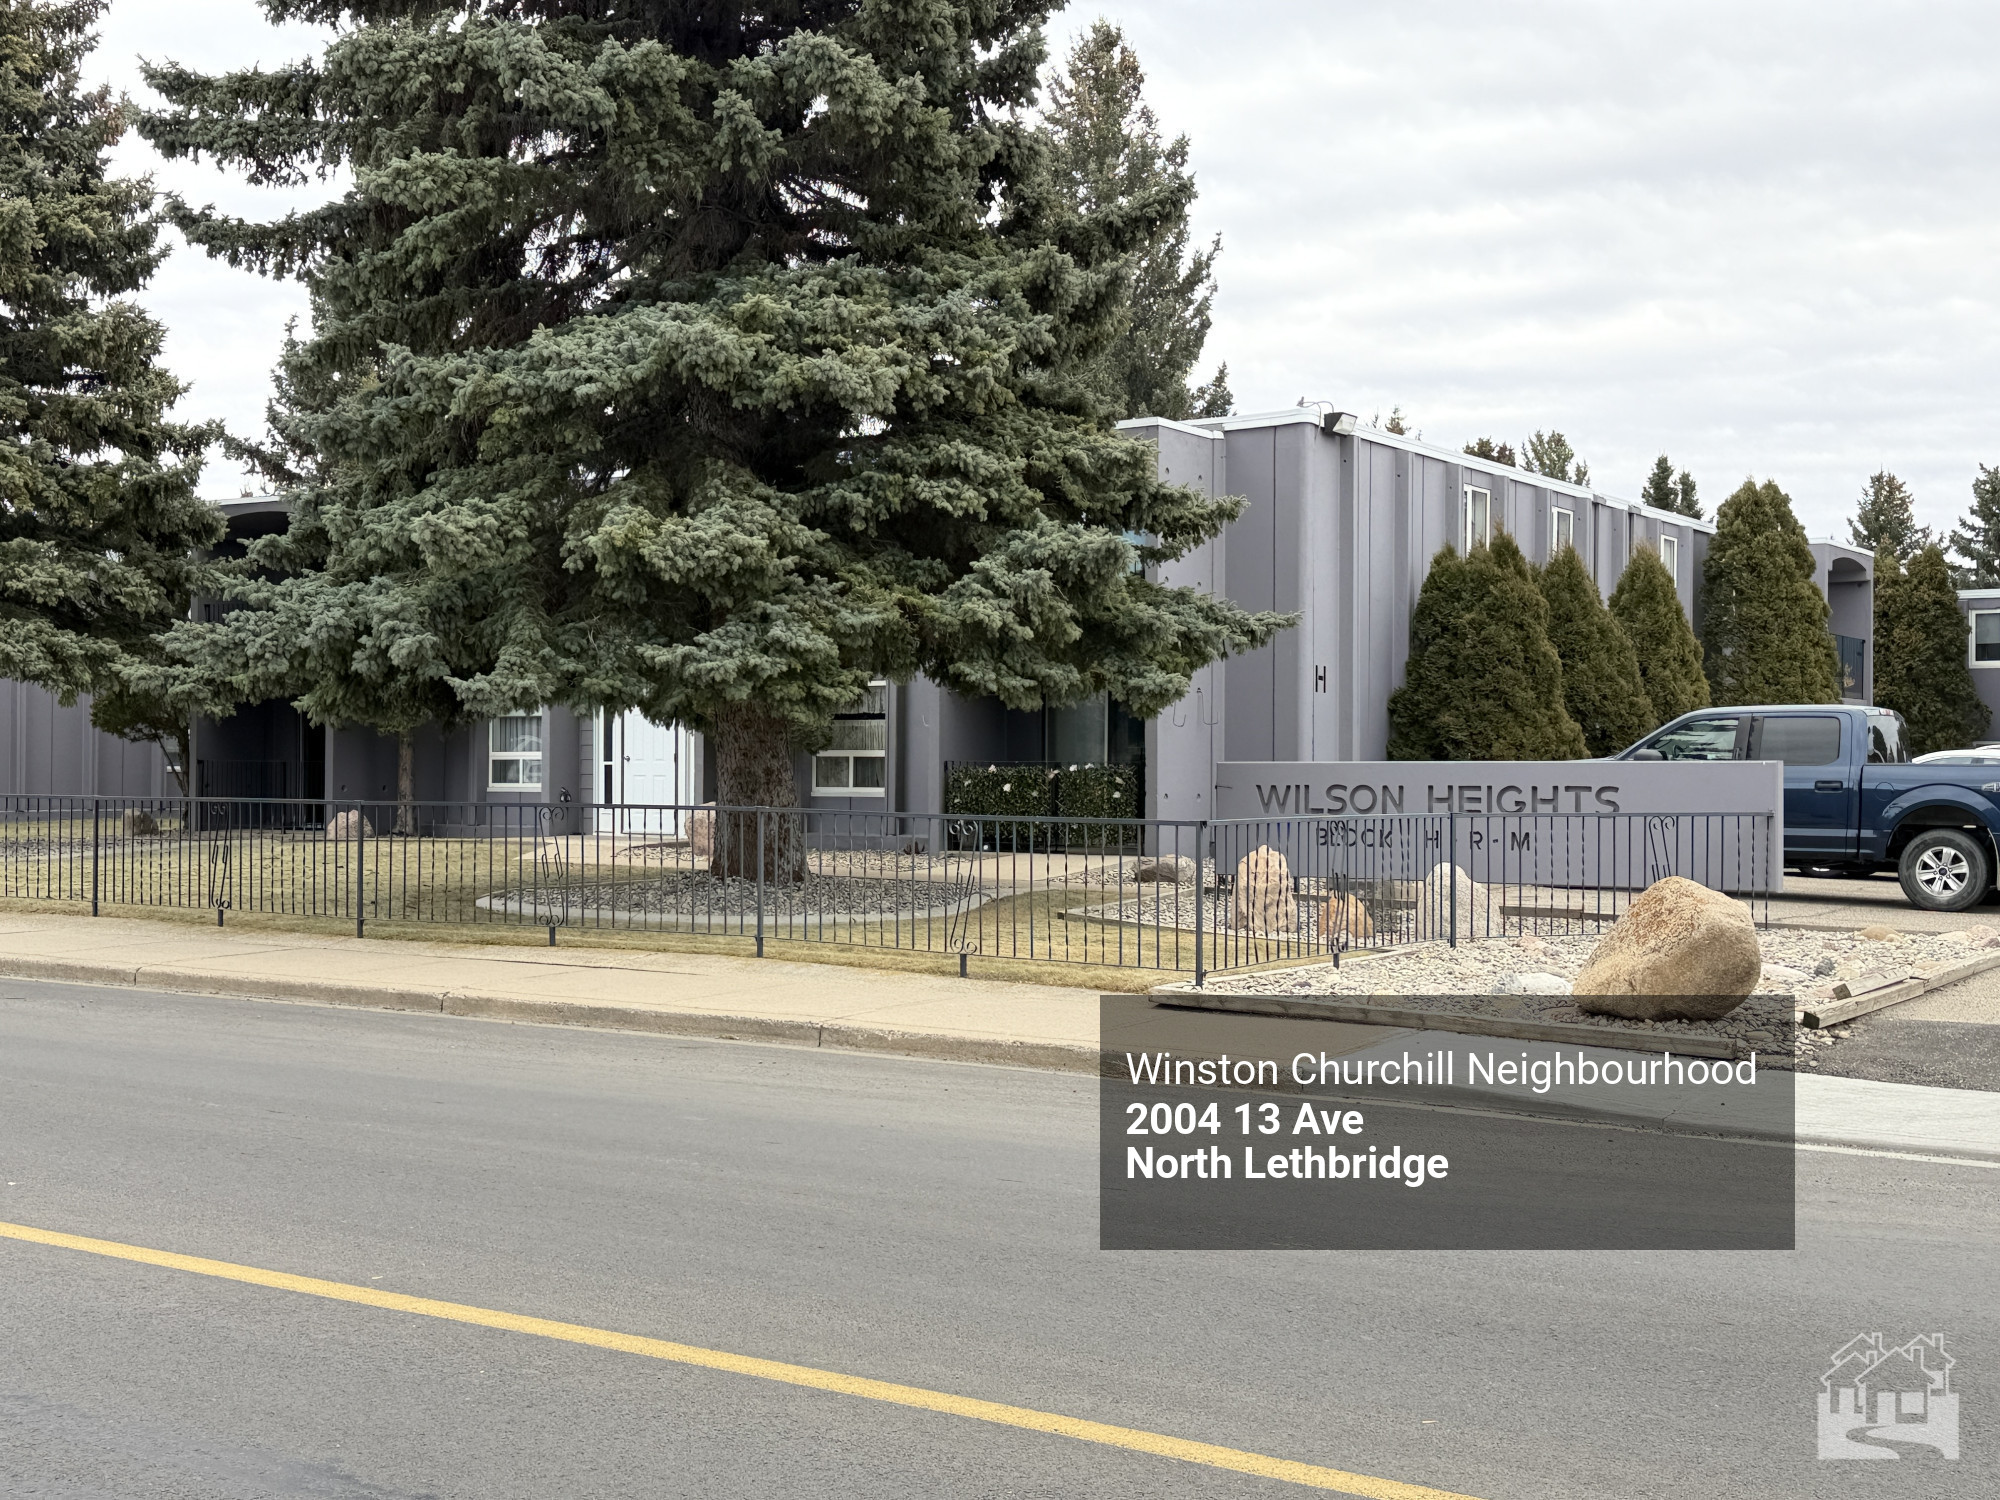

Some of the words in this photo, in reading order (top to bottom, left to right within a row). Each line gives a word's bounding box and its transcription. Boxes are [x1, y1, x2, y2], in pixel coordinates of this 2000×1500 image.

[1315, 664, 1326, 694] H
[1255, 784, 1404, 816] WILSON
[1427, 785, 1620, 817] HEIGHTS
